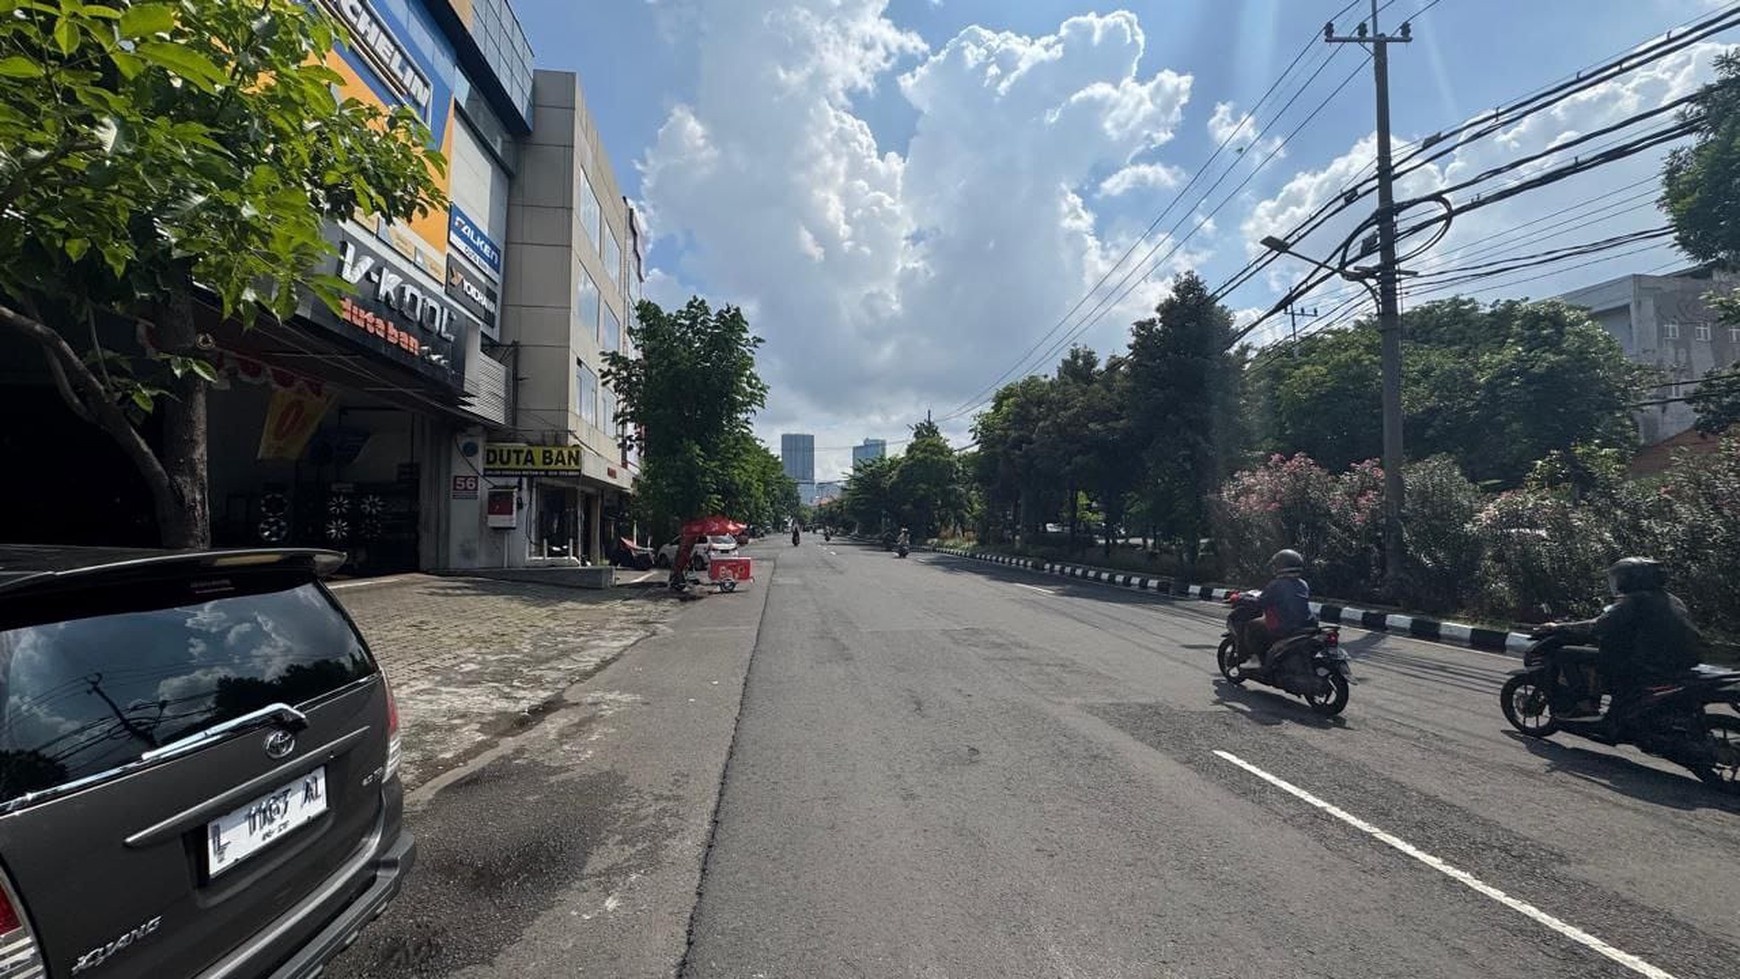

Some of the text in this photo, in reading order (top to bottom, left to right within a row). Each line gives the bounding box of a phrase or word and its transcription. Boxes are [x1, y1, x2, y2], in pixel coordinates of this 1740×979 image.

[454, 215, 499, 264] FALKEN
[341, 241, 457, 342] V-KOOL
[341, 297, 420, 356] duta ban
[486, 449, 580, 466] DUTA BAN
[455, 477, 477, 490] 56
